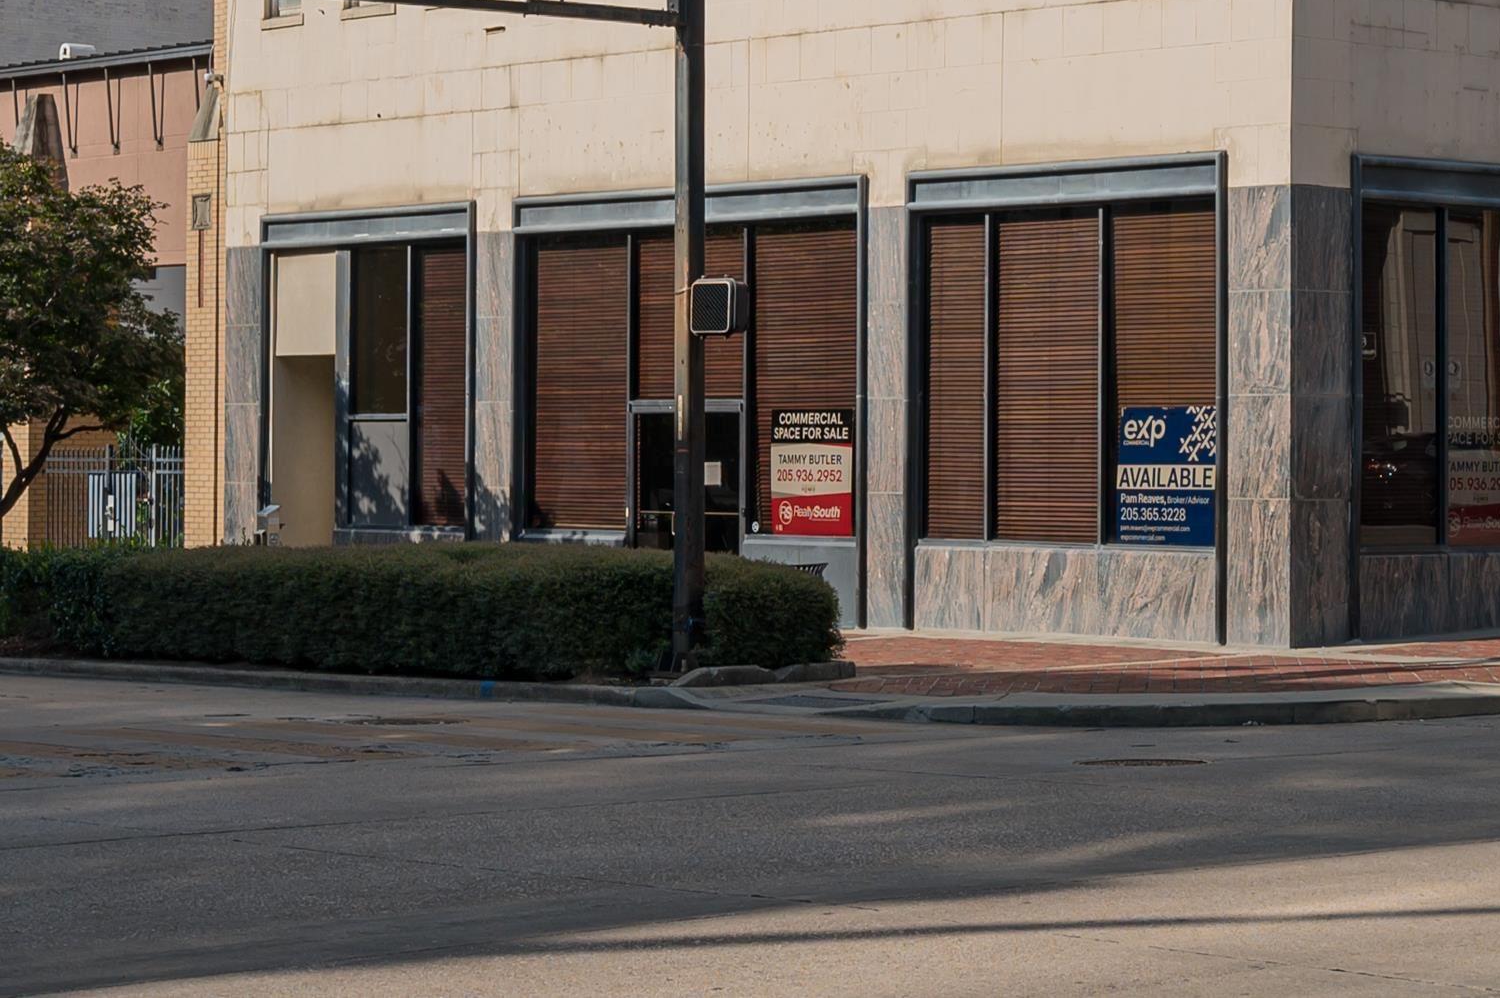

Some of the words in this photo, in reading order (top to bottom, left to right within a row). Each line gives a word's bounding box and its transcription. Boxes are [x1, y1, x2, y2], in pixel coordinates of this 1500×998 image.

[779, 412, 844, 425] COMMERCIAL
[773, 427, 800, 440] SPACE
[802, 427, 822, 440] FOR
[823, 427, 849, 440] SALE
[778, 454, 807, 465] TAMMY
[809, 454, 842, 465] BUTLER
[777, 469, 843, 482] 205.936.2952
[1119, 467, 1213, 488] AVAILABLE
[1120, 493, 1137, 504] Pam
[1138, 493, 1166, 505] Reaves,
[1120, 507, 1186, 521] 205.365.3228
